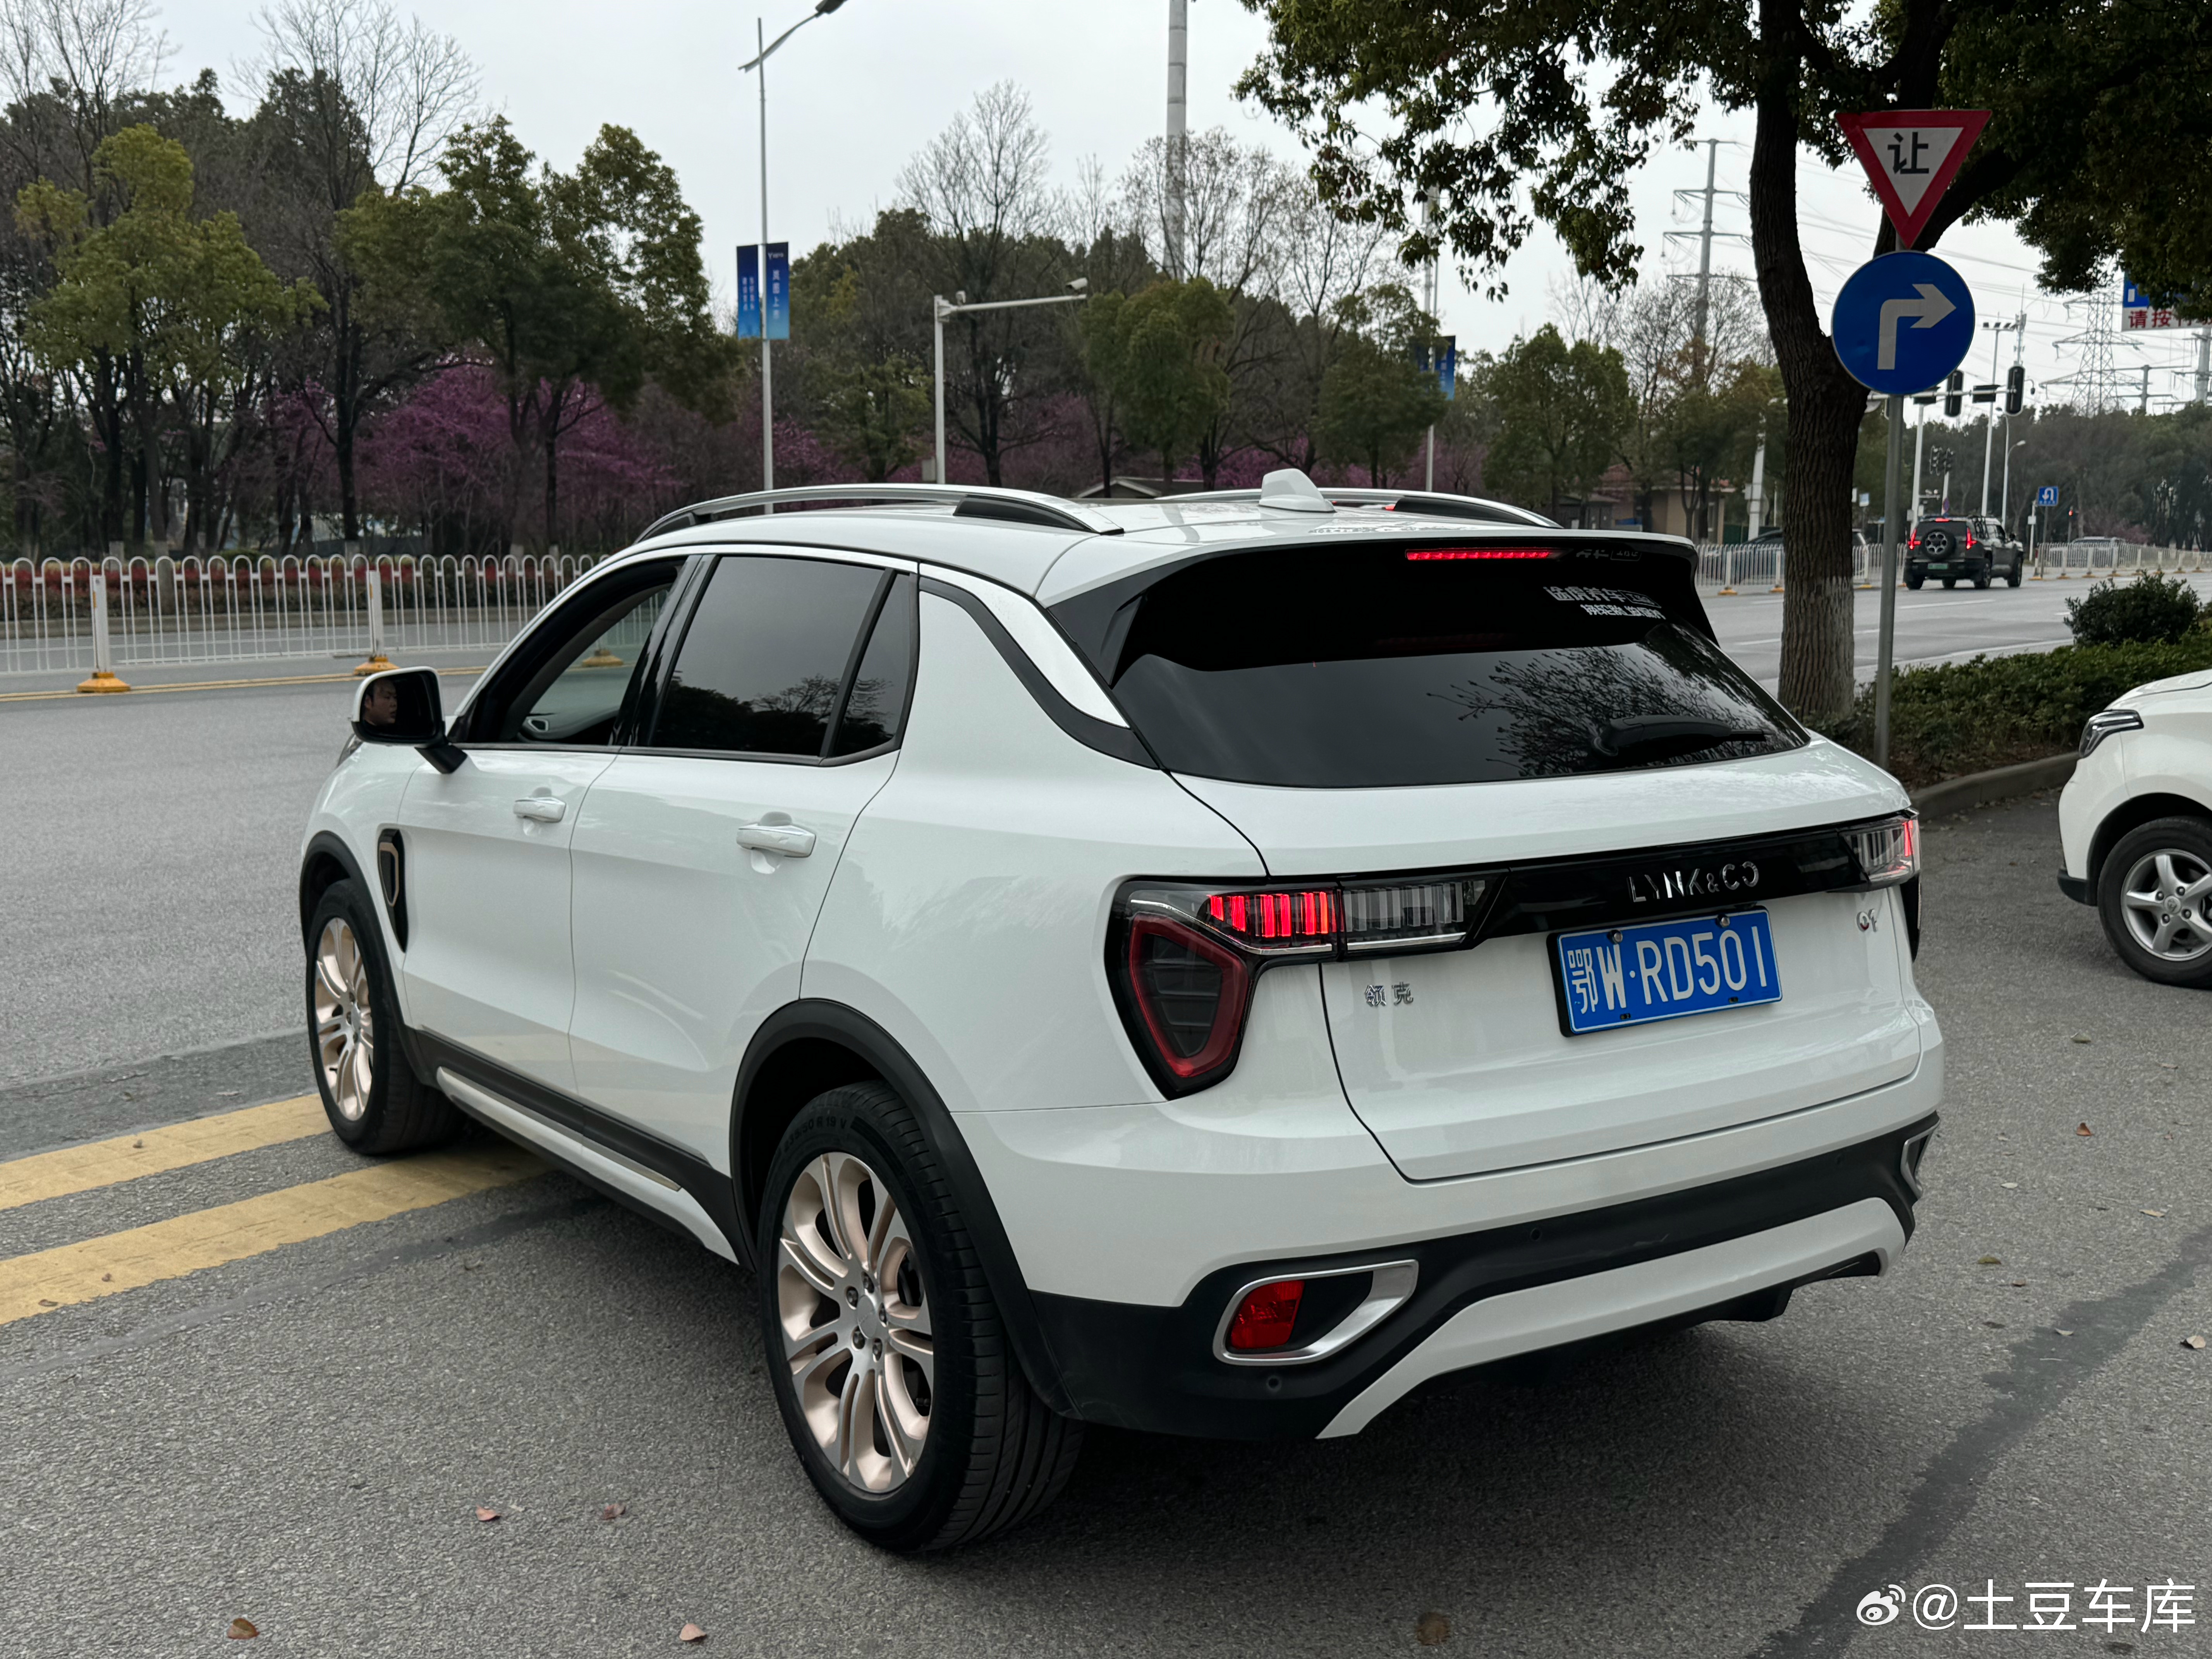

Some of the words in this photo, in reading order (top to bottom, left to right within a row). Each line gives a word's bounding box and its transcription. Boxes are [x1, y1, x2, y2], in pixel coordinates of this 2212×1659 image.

[1887, 131, 1929, 175] 让
[2128, 309, 2212, 329] 请按
[1543, 586, 1626, 602] 途虎养车
[1628, 861, 1759, 902] LYNK&CO
[1567, 926, 1767, 1014] 鄂W·RD501
[1365, 981, 1413, 1007] 领克
[826, 1116, 836, 1127] 19
